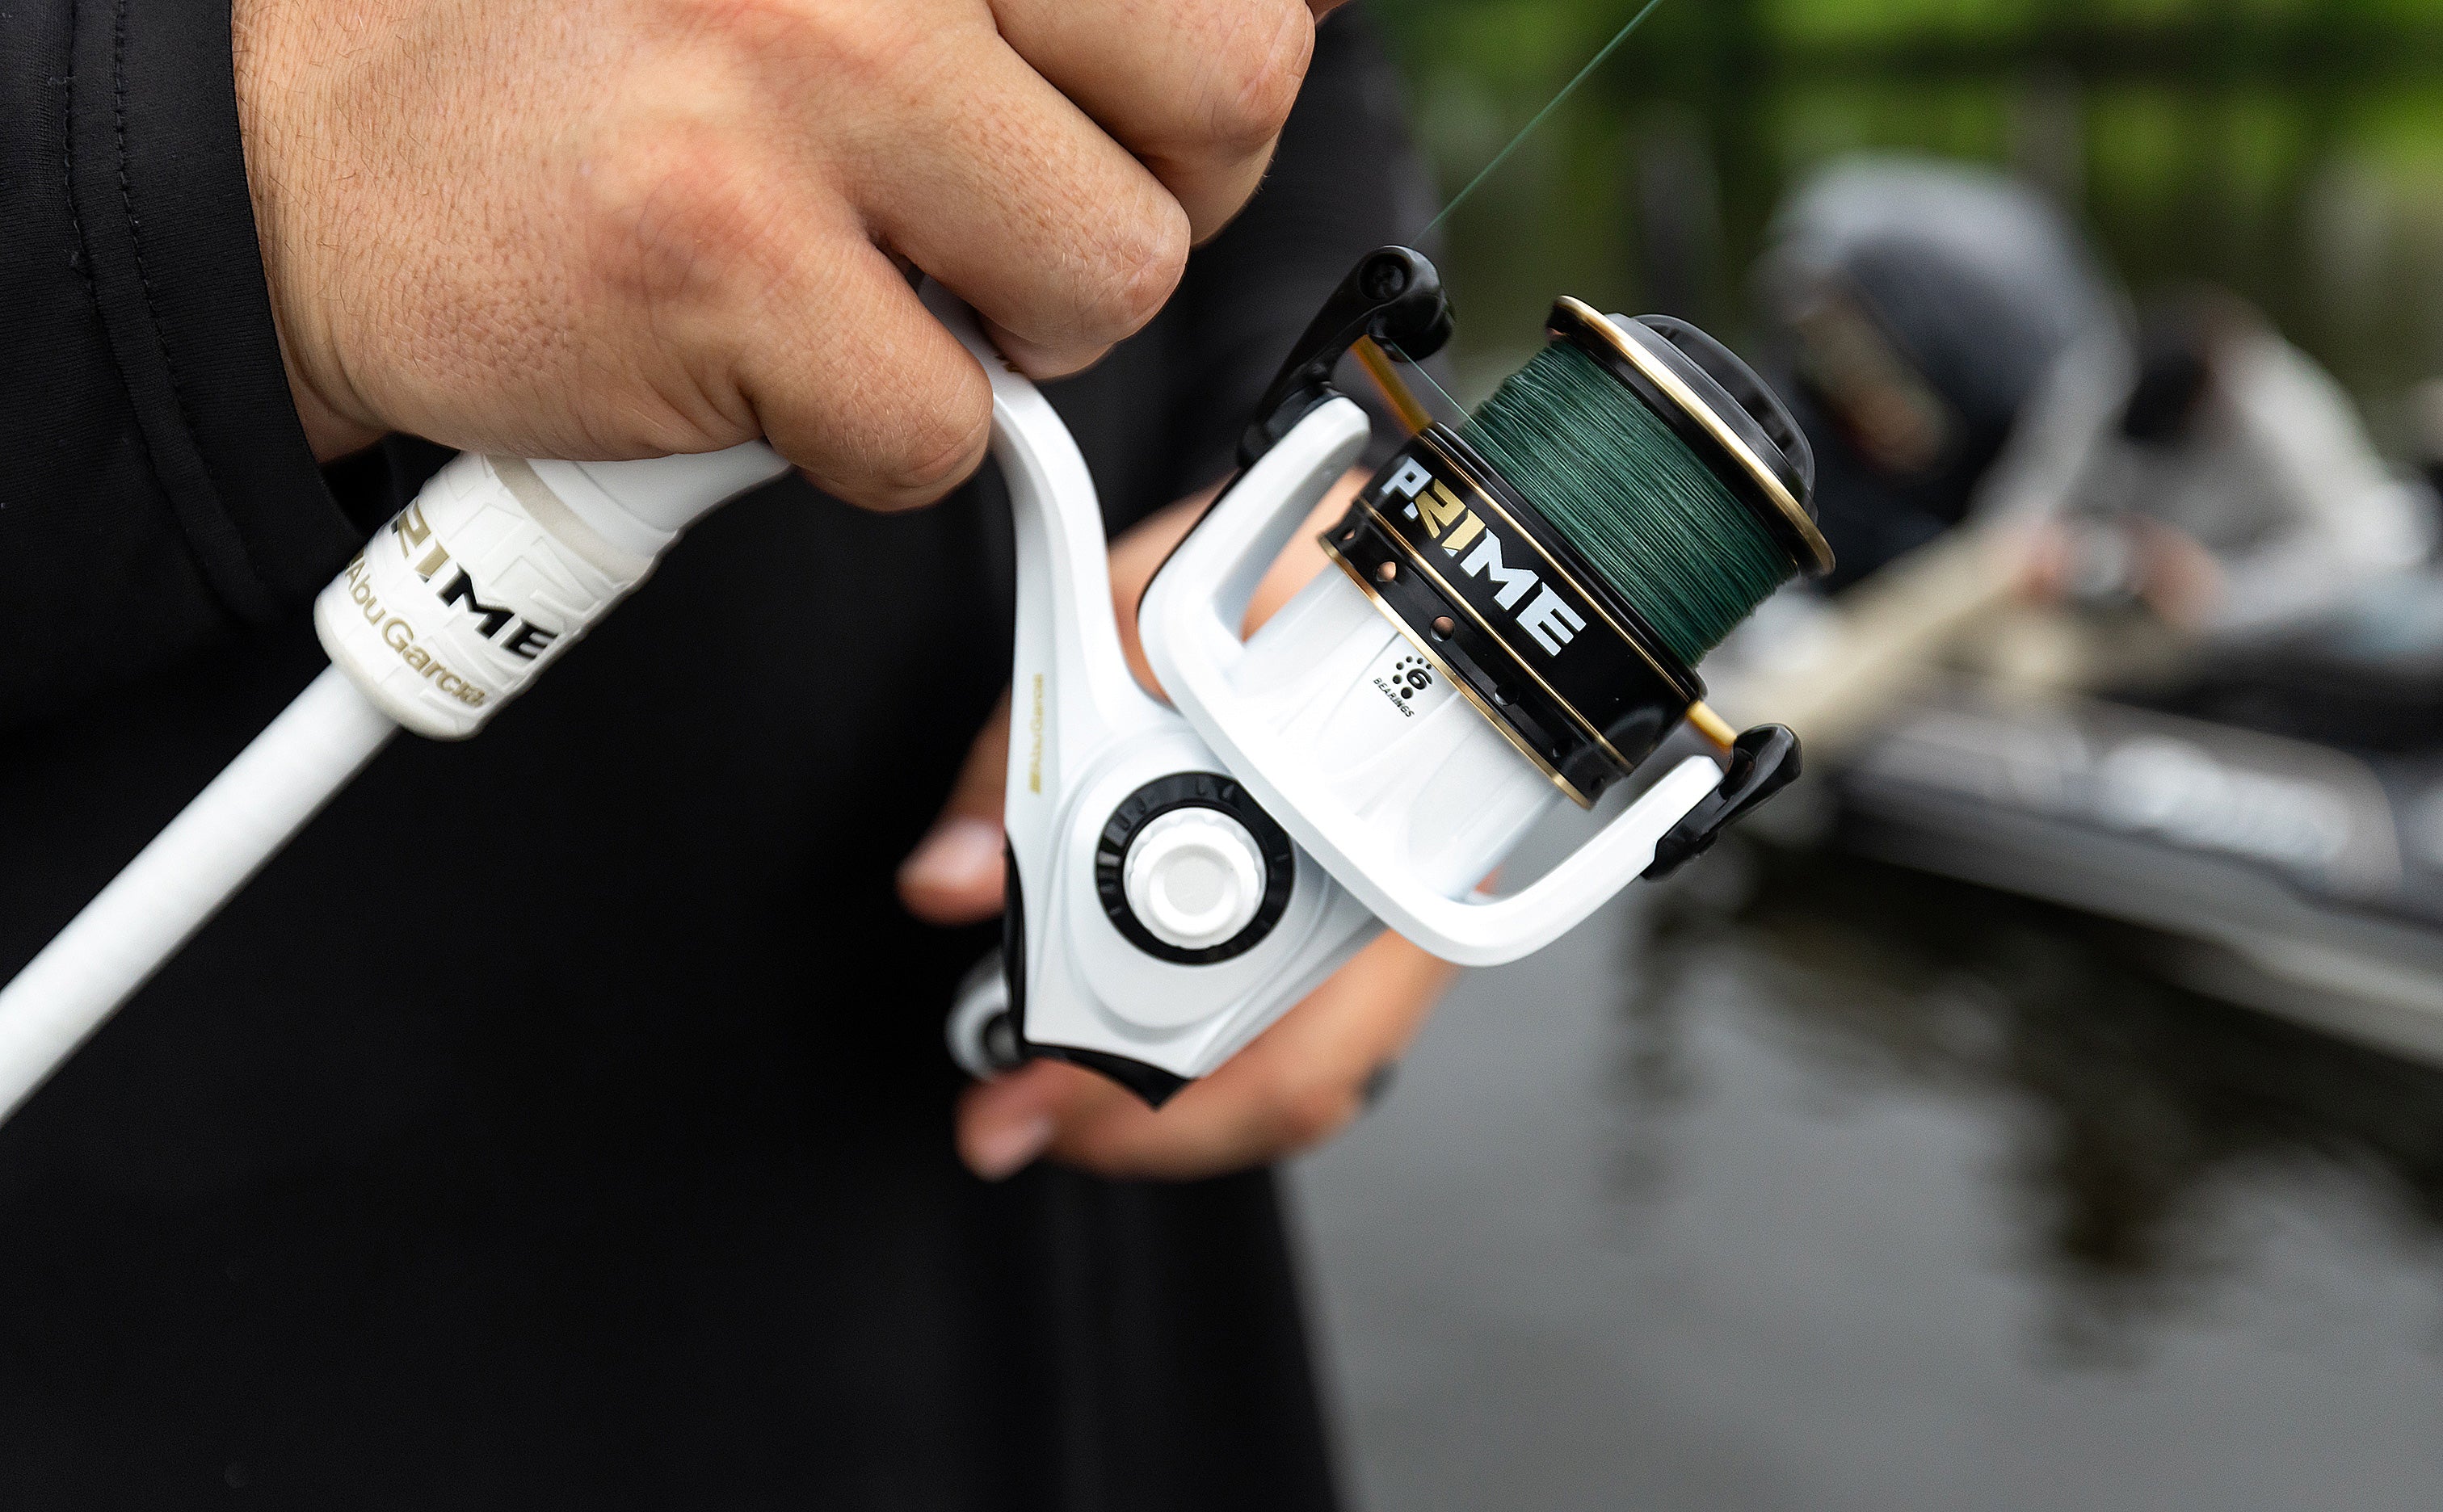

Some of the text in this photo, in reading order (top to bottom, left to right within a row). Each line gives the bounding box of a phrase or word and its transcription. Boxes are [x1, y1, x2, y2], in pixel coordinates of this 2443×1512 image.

[390, 498, 559, 660] RIME
[1380, 457, 1587, 657] PRIME
[345, 560, 386, 625] Abu
[1373, 678, 1415, 717] BEARINGS
[1406, 668, 1432, 690] 6
